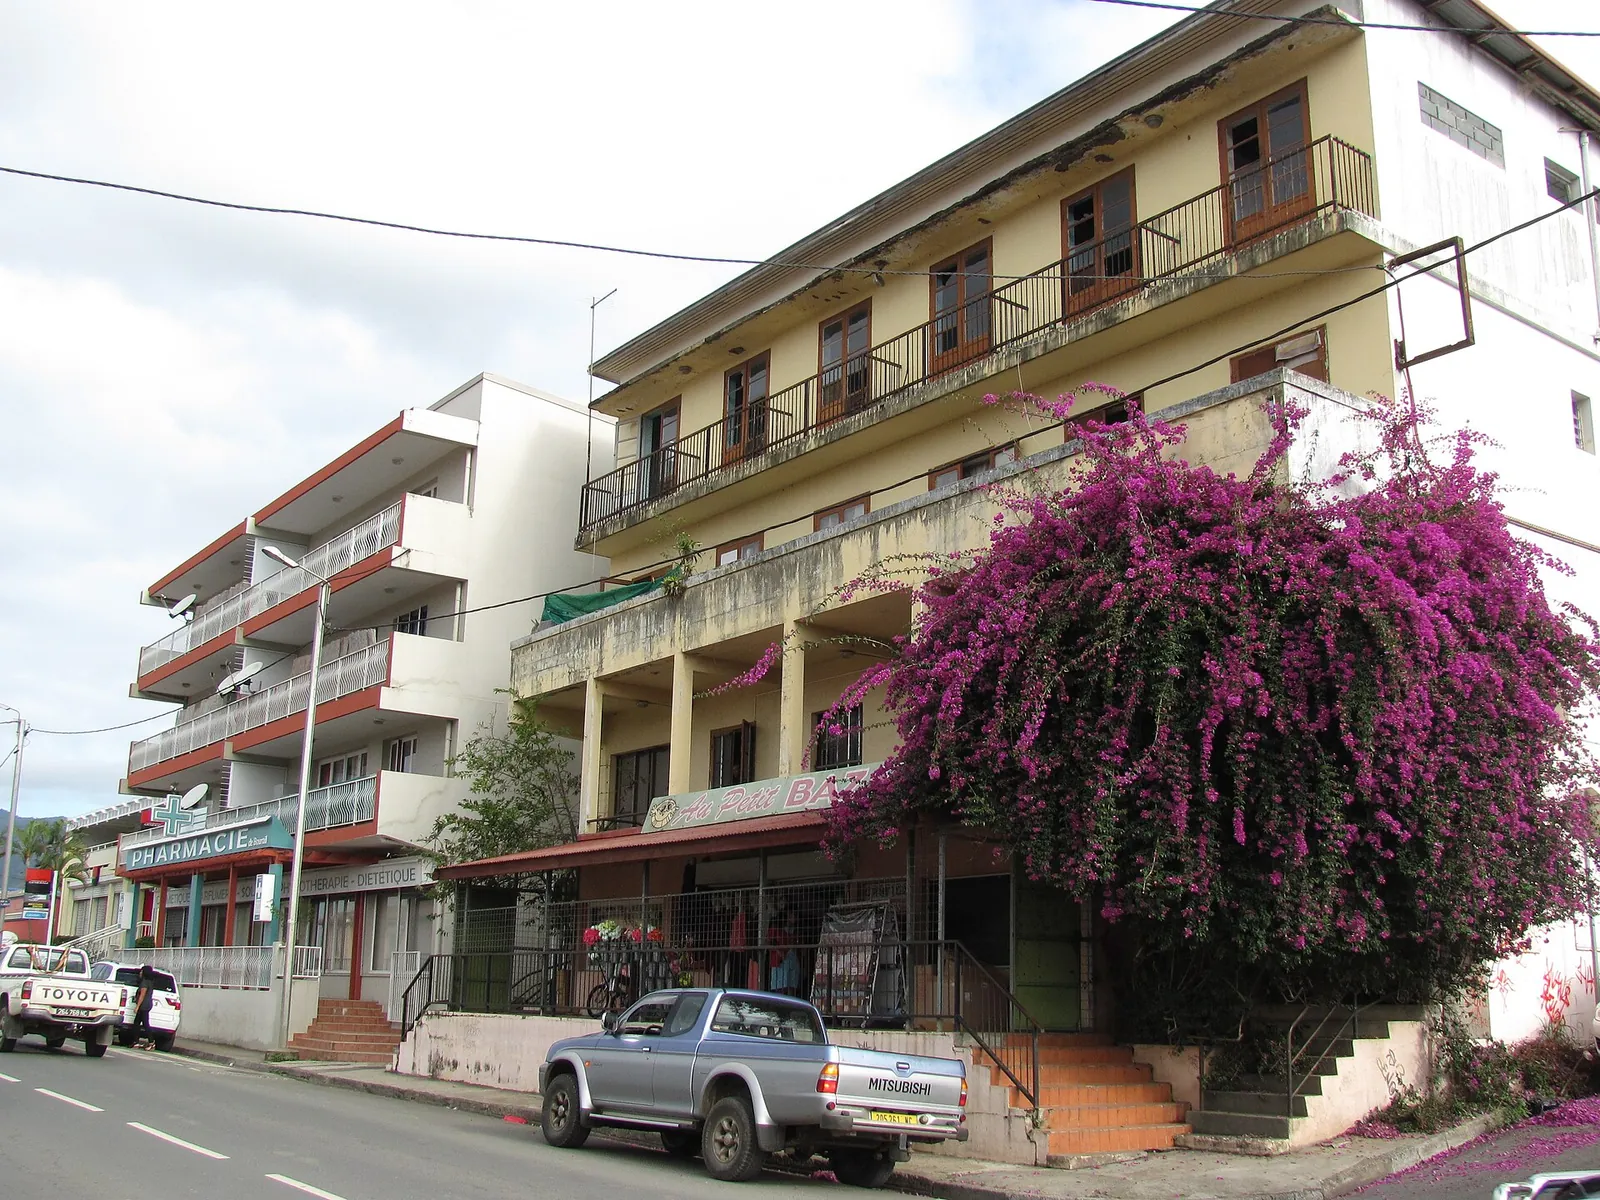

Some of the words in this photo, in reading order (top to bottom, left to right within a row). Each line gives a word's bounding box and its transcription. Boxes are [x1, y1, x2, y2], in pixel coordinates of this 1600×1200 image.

[672, 792, 712, 826] Au
[716, 784, 781, 820] Petit
[783, 766, 871, 810] BAZ
[131, 828, 249, 867] PHARMACIE
[357, 867, 416, 887] DIETETIQUE
[42, 987, 110, 1003] TOYOTA
[868, 1077, 931, 1096] MITSUBISHI
